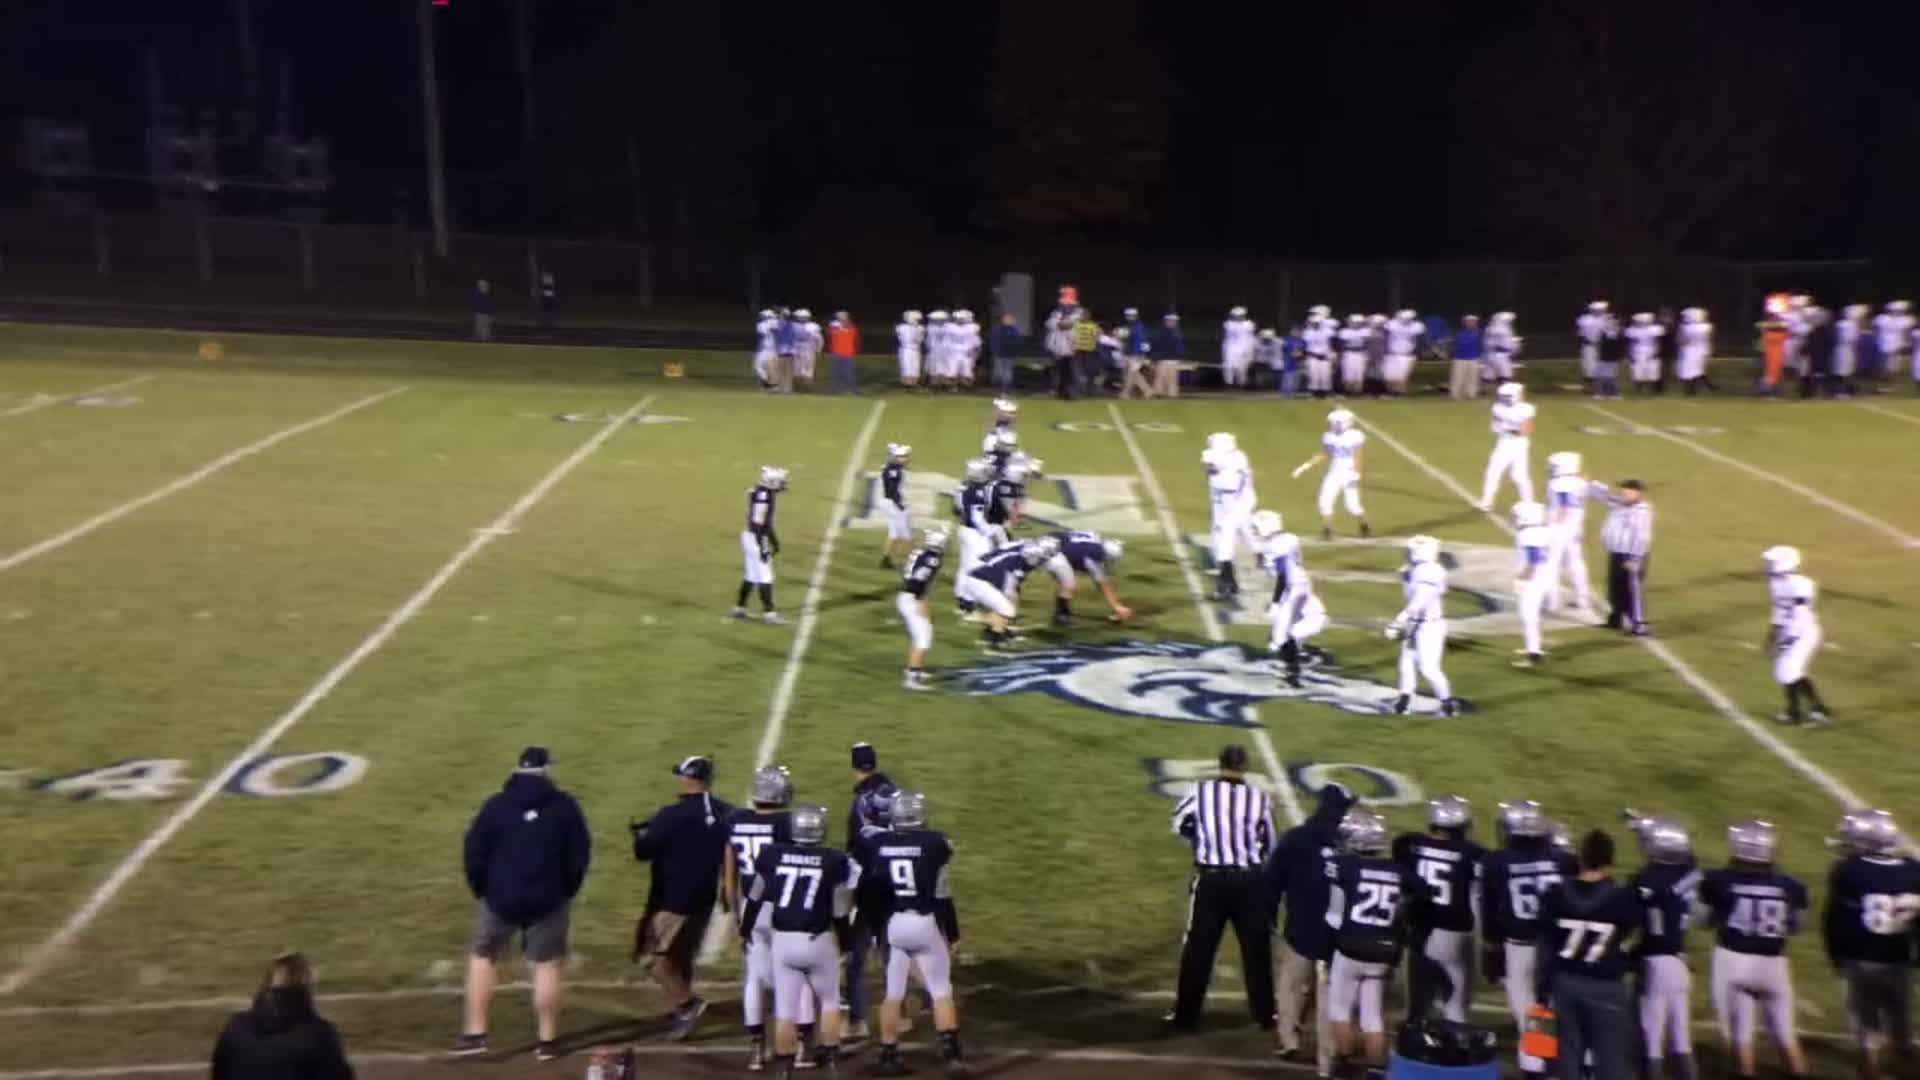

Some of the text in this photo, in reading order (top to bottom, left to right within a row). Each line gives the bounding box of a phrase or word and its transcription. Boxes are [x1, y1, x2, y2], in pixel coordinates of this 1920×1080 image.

[776, 866, 823, 909] 77
[889, 859, 917, 896] 9
[1350, 881, 1399, 927] 25
[1728, 897, 1787, 938] 48
[1557, 918, 1615, 962] 77
